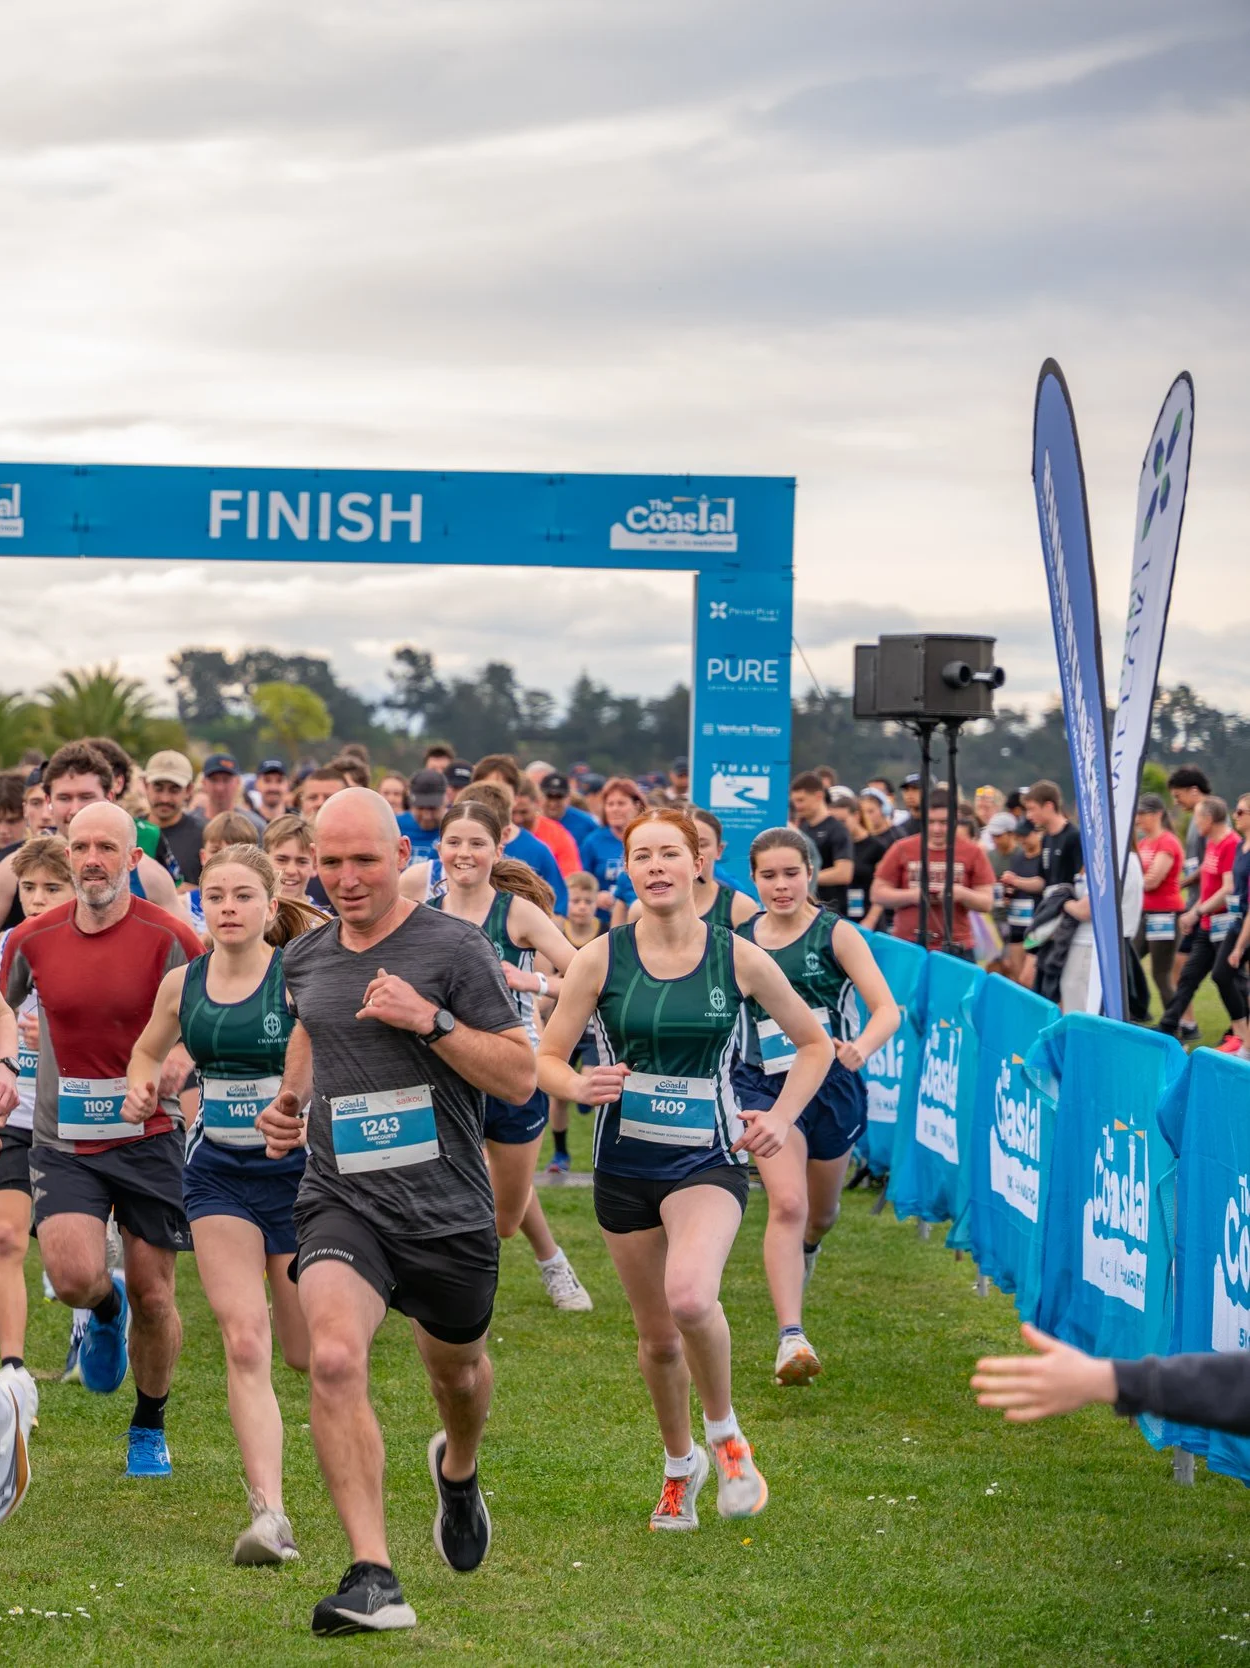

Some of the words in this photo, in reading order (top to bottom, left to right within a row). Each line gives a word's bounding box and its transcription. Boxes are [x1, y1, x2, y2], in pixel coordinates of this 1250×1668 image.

[648, 499, 673, 512] The
[209, 490, 423, 542] FINISH
[625, 496, 735, 532] Coastal
[707, 658, 779, 683] PURE
[716, 724, 750, 734] Venture
[751, 724, 781, 735] Timaru
[711, 763, 770, 774] TIMARU
[83, 1100, 114, 1113] 1109
[339, 1096, 367, 1110] Coastal
[396, 1095, 423, 1106] saikou
[650, 1099, 687, 1115] 1409
[228, 1103, 258, 1117] 1413
[360, 1116, 401, 1136] 1243
[366, 1133, 397, 1141] HARCOURTS
